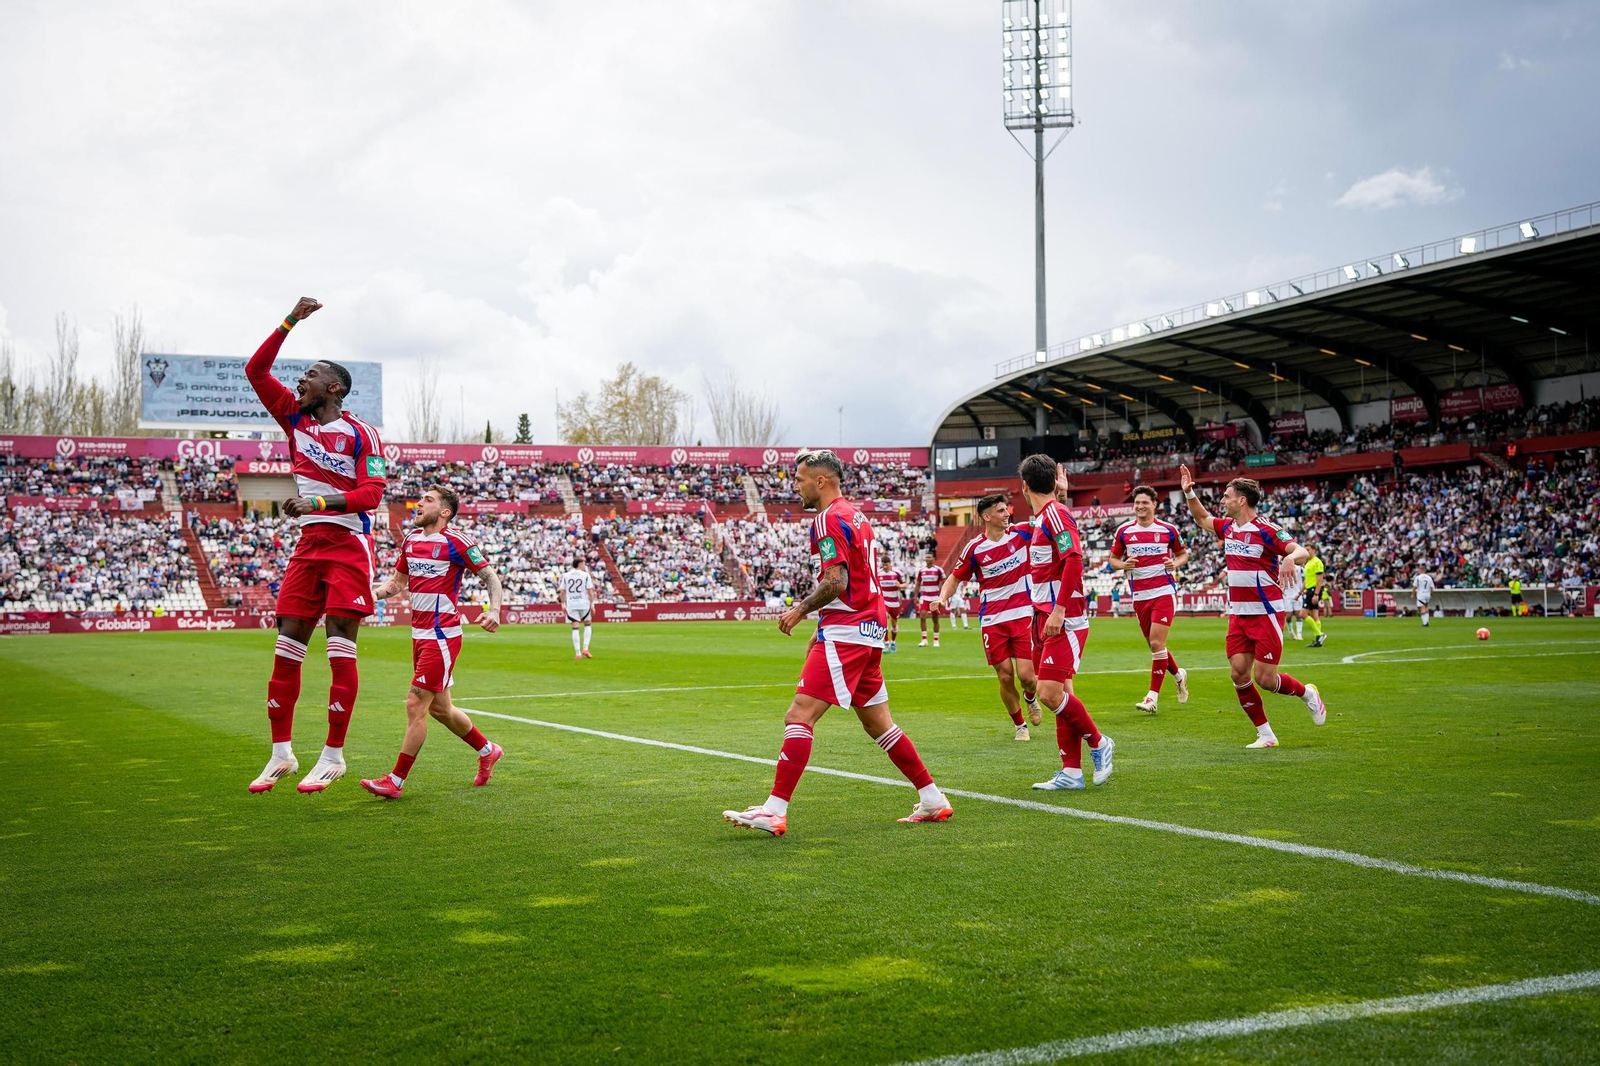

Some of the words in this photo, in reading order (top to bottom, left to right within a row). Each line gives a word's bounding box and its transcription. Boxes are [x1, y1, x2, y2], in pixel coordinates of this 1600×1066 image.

[190, 384, 238, 392] animas
[1484, 387, 1520, 400] AVECCO
[186, 394, 222, 403] hacia
[1391, 397, 1424, 415] juanjo
[1275, 416, 1306, 428] Globalcaja
[1142, 428, 1174, 440] BUSINESS
[177, 440, 229, 460] GOL
[248, 462, 291, 473] SOAB
[568, 578, 583, 593] 22
[1424, 580, 1428, 588] 7
[1191, 596, 1224, 609] LALIGA
[604, 610, 632, 618] Mahou
[96, 619, 150, 632] Globalcaja
[984, 633, 989, 648] 2
